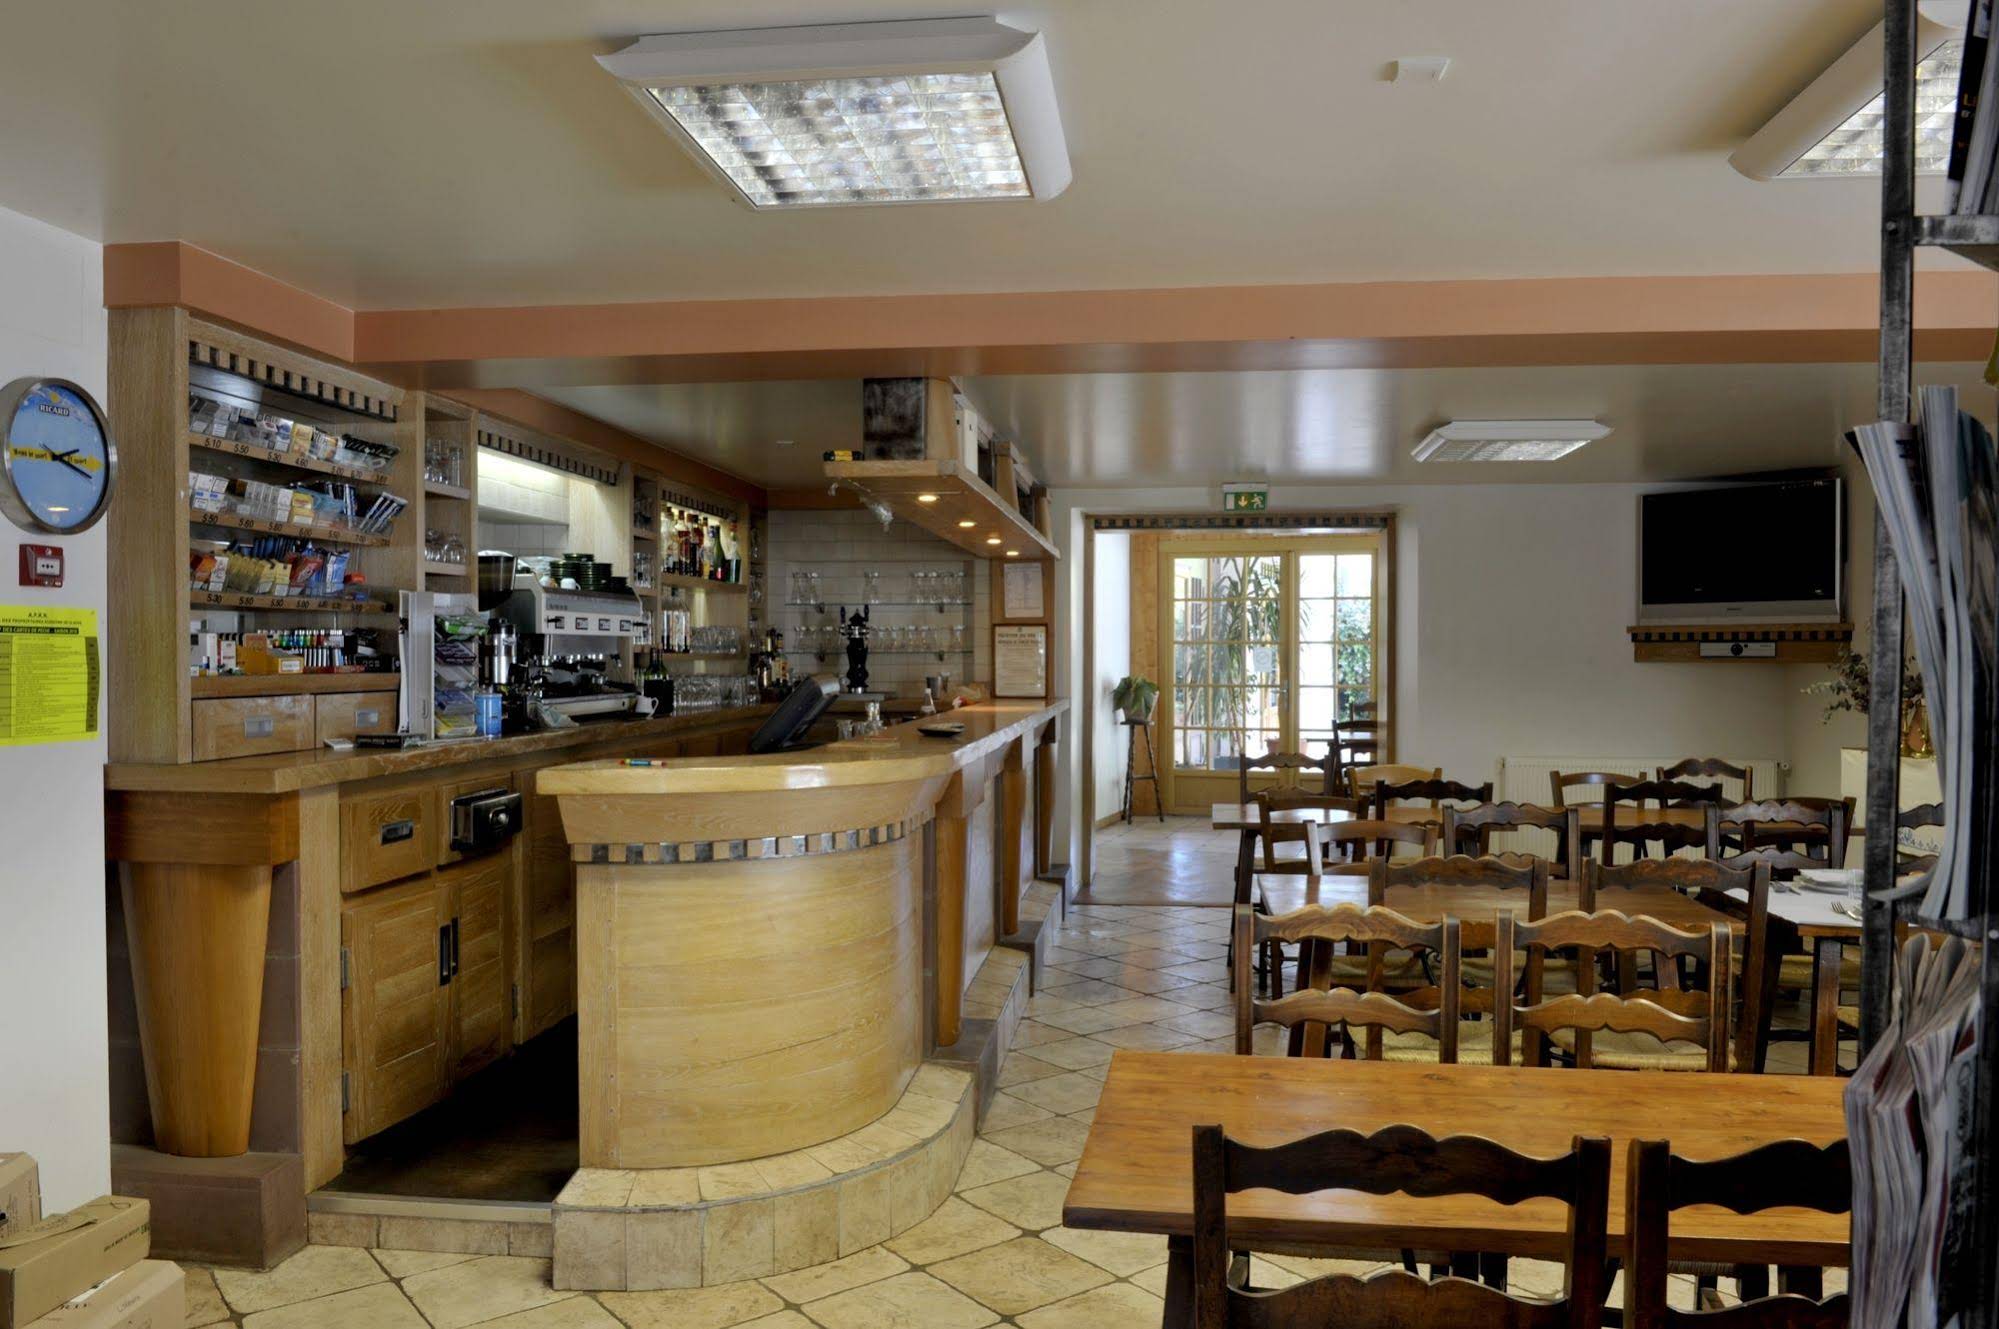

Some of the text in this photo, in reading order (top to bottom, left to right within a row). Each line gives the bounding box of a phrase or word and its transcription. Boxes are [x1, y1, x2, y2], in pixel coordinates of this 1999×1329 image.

[40, 404, 69, 416] RICARD
[204, 438, 222, 449] 5.10
[233, 443, 250, 454] 5.50
